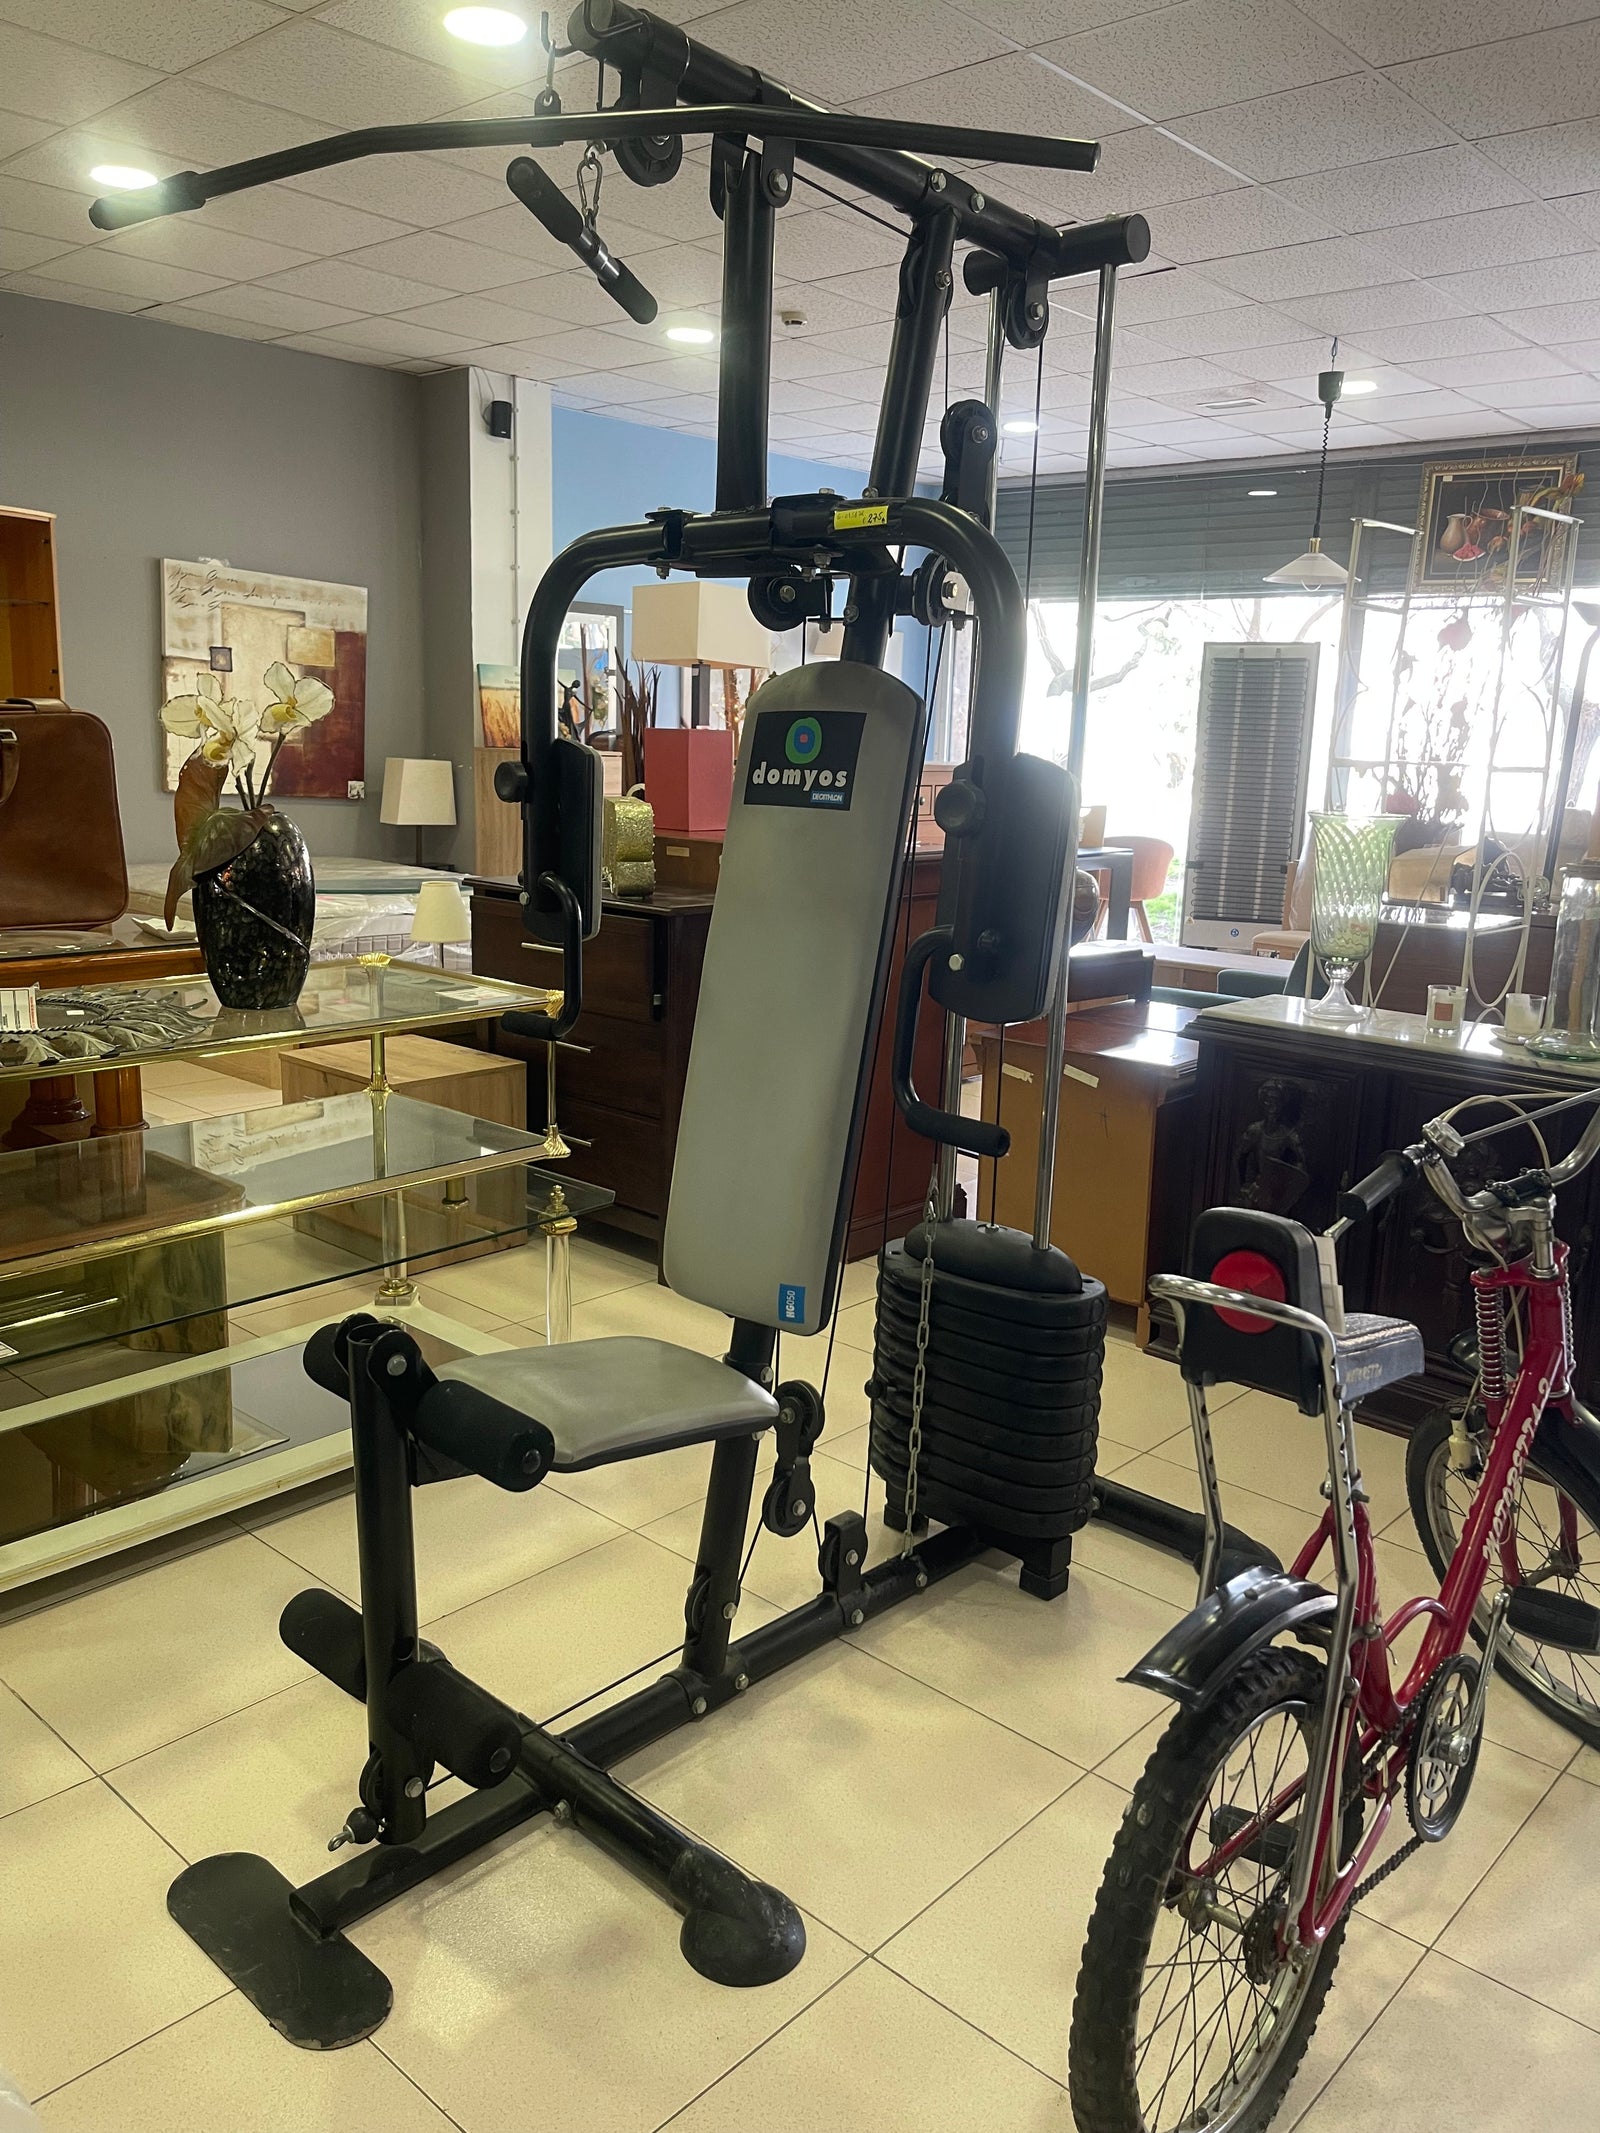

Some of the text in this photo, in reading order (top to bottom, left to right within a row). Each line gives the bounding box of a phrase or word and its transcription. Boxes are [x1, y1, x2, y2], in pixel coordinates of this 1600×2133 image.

[752, 761, 848, 791] domyos
[812, 792, 843, 802] DECATHLON
[785, 1290, 796, 1318] HG050
